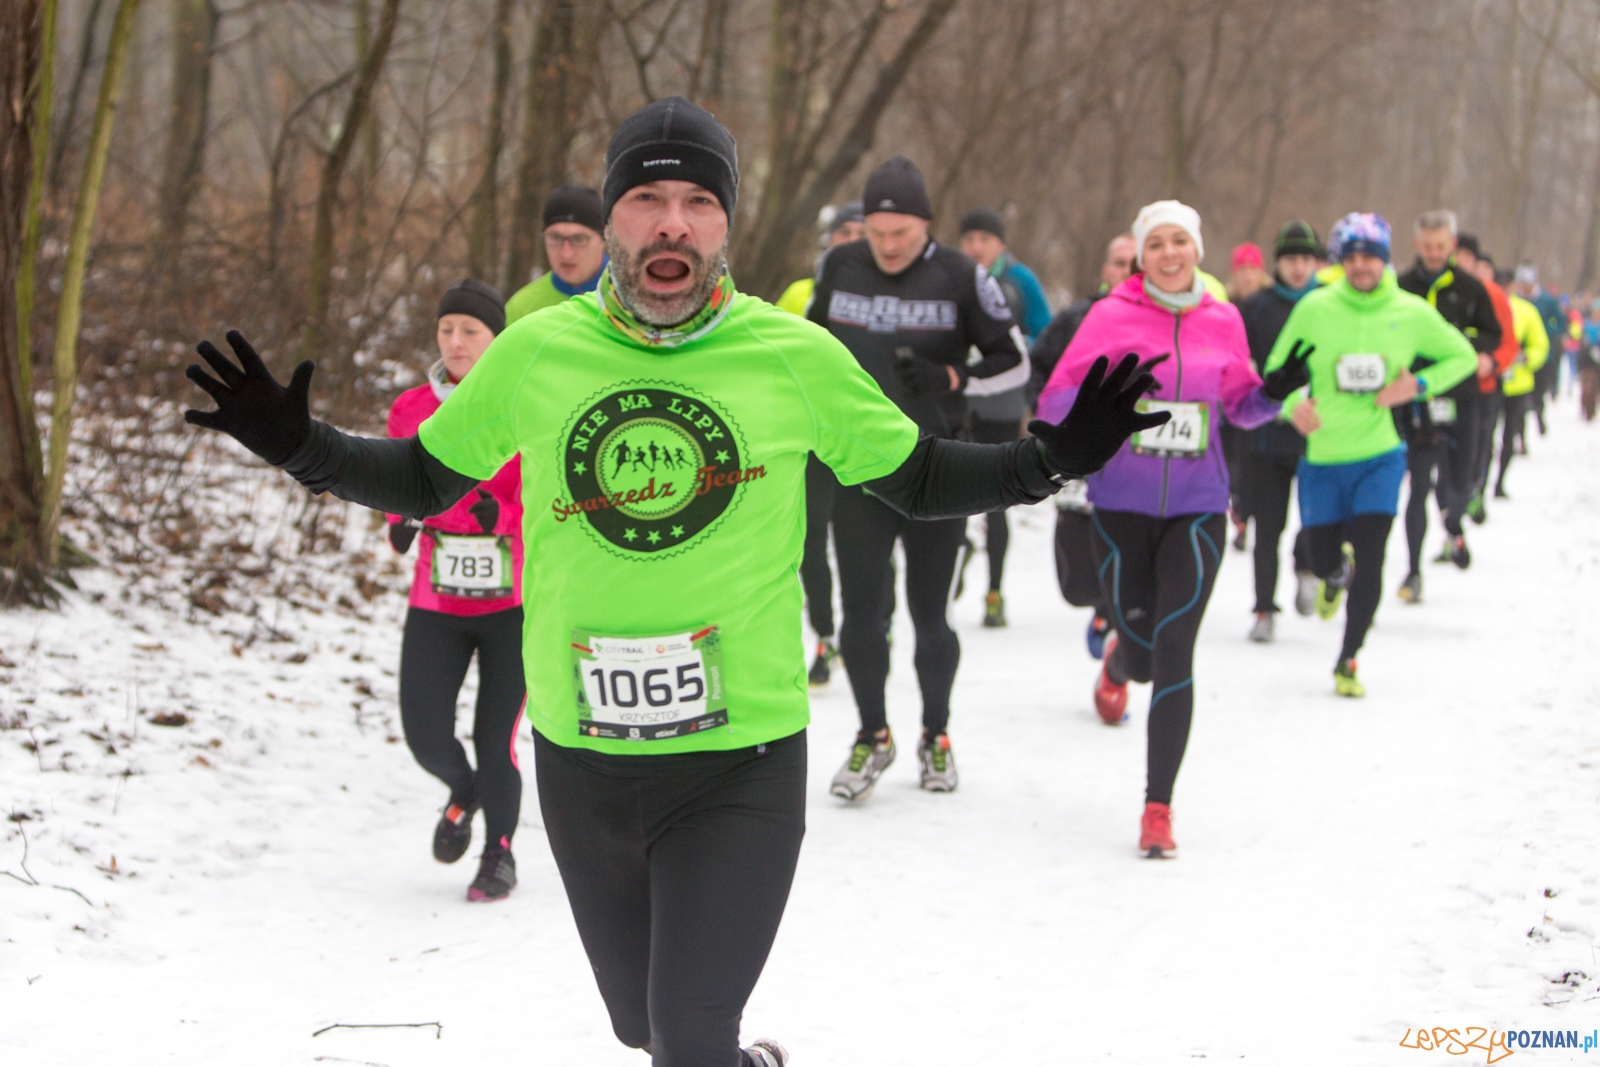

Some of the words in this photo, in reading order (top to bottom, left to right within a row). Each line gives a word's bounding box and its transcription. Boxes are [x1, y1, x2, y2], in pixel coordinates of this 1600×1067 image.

[571, 409, 610, 453] NIE
[617, 394, 653, 413] MA
[666, 397, 726, 442] LIPY
[696, 464, 767, 496] Team
[446, 555, 493, 577] 783
[590, 661, 704, 708] 1065
[619, 709, 681, 723] KRZYSZTOF
